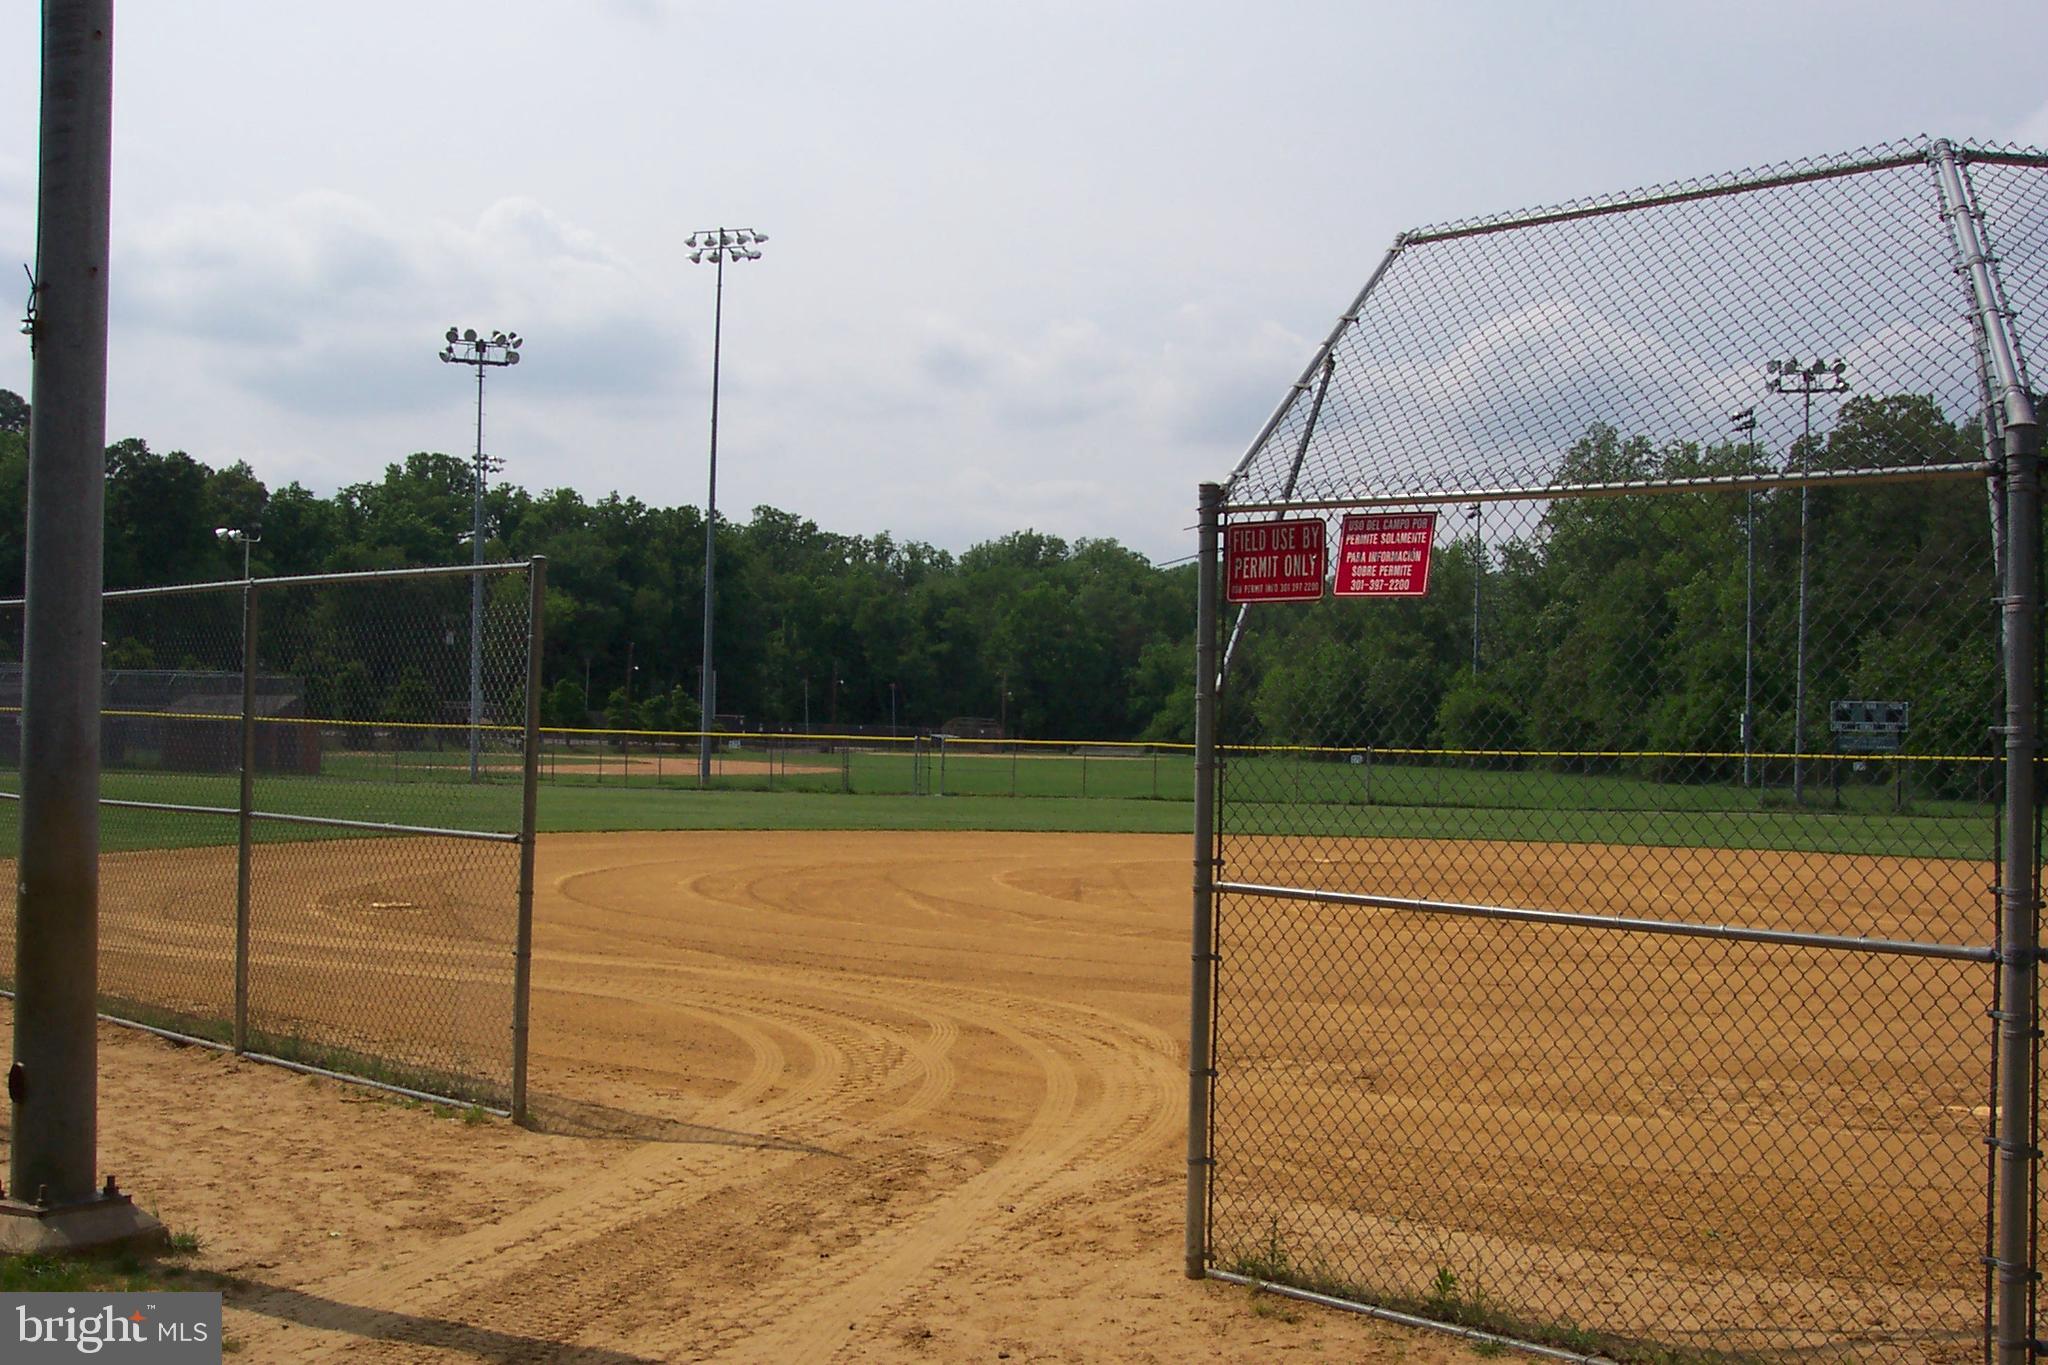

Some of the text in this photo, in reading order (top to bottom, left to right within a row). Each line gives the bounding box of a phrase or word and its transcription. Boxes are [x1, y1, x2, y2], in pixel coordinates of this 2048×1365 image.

[1348, 518, 1428, 531] USO DEL CAMPO POR
[1233, 526, 1320, 552] FIELD USE BY
[1345, 532, 1428, 545] PERMITE SOLAMENTE
[1346, 547, 1422, 563] PARA INFORMACIÓN
[1234, 553, 1318, 579] PERMIT ONLY
[1351, 565, 1413, 577] SOBRE PERMITE
[1244, 584, 1264, 594] PERMIT
[1265, 583, 1279, 593] INFO
[1280, 583, 1291, 593] 301
[1304, 582, 1320, 592] 2200
[1350, 579, 1410, 591] 301-397-2200
